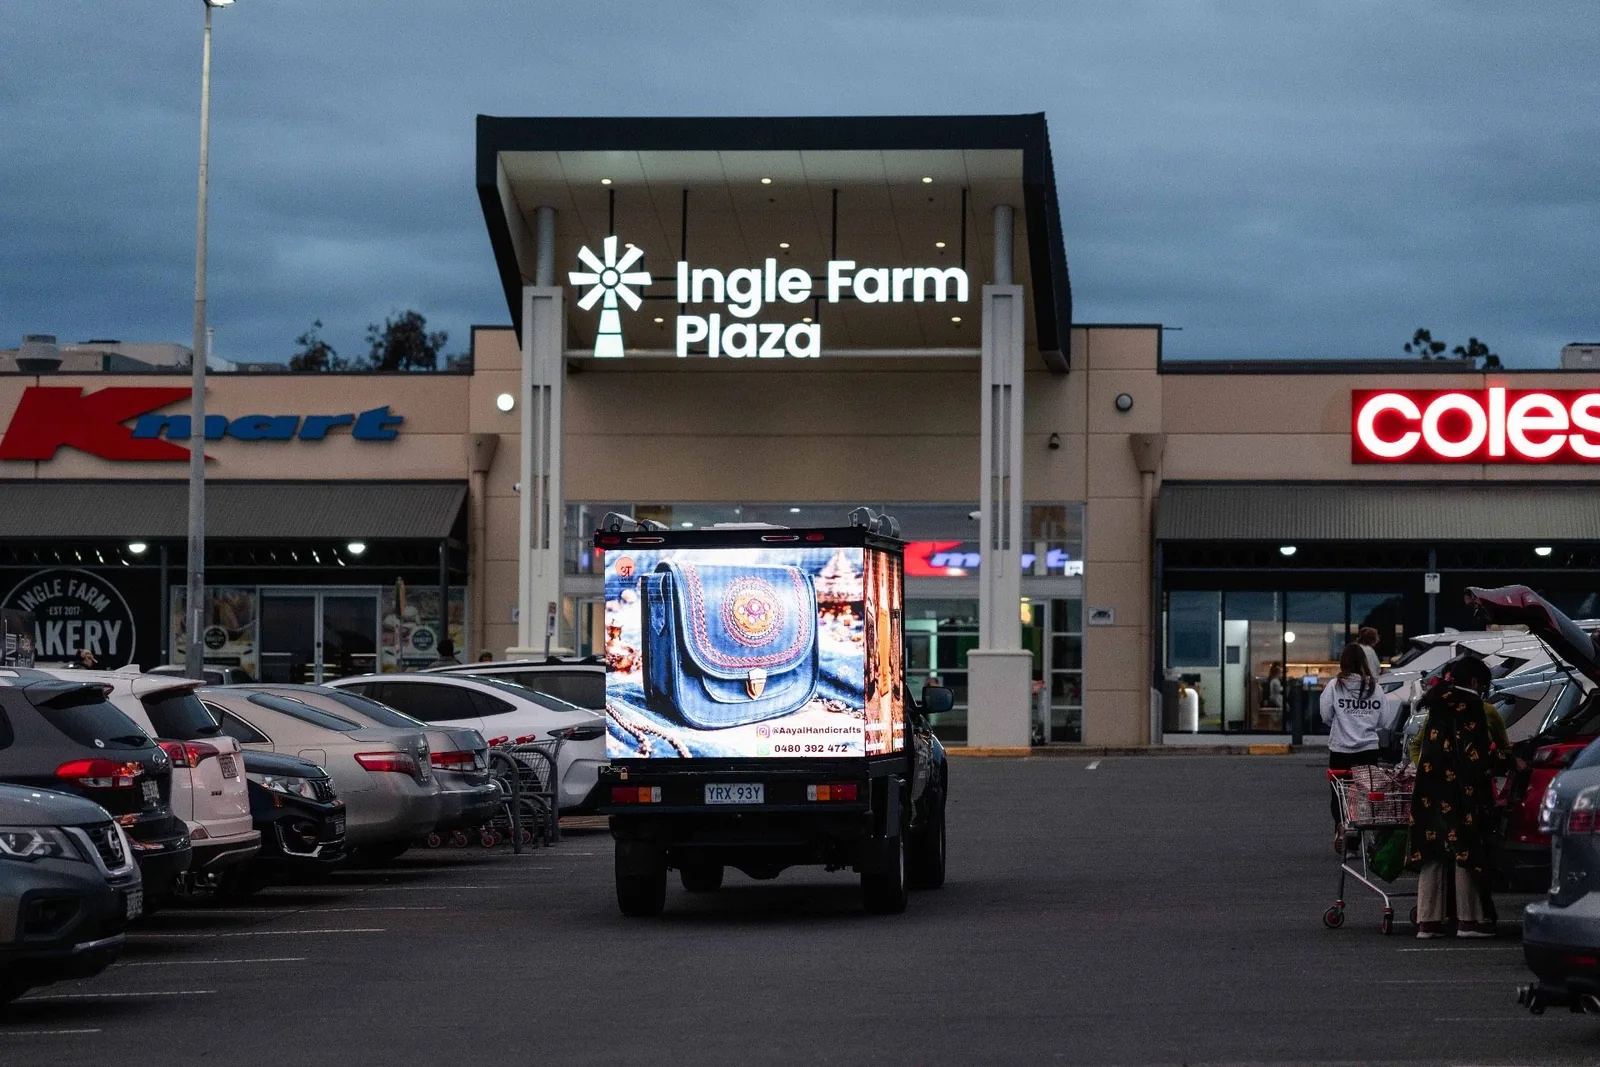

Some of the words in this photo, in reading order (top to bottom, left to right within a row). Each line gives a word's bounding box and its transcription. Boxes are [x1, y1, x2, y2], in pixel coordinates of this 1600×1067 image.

[676, 257, 812, 318] Ingle
[828, 260, 969, 303] Farm
[676, 312, 821, 358] Plaza
[0, 386, 404, 461] Kmart
[1357, 387, 1600, 458] coles
[17, 579, 64, 612] INGLE
[67, 579, 111, 614] FARM
[49, 606, 62, 616] EST
[64, 606, 81, 616] 2017
[1338, 698, 1381, 710] STUDIO
[774, 744, 801, 753] 0480
[804, 744, 824, 753] 392
[827, 744, 848, 753] 472
